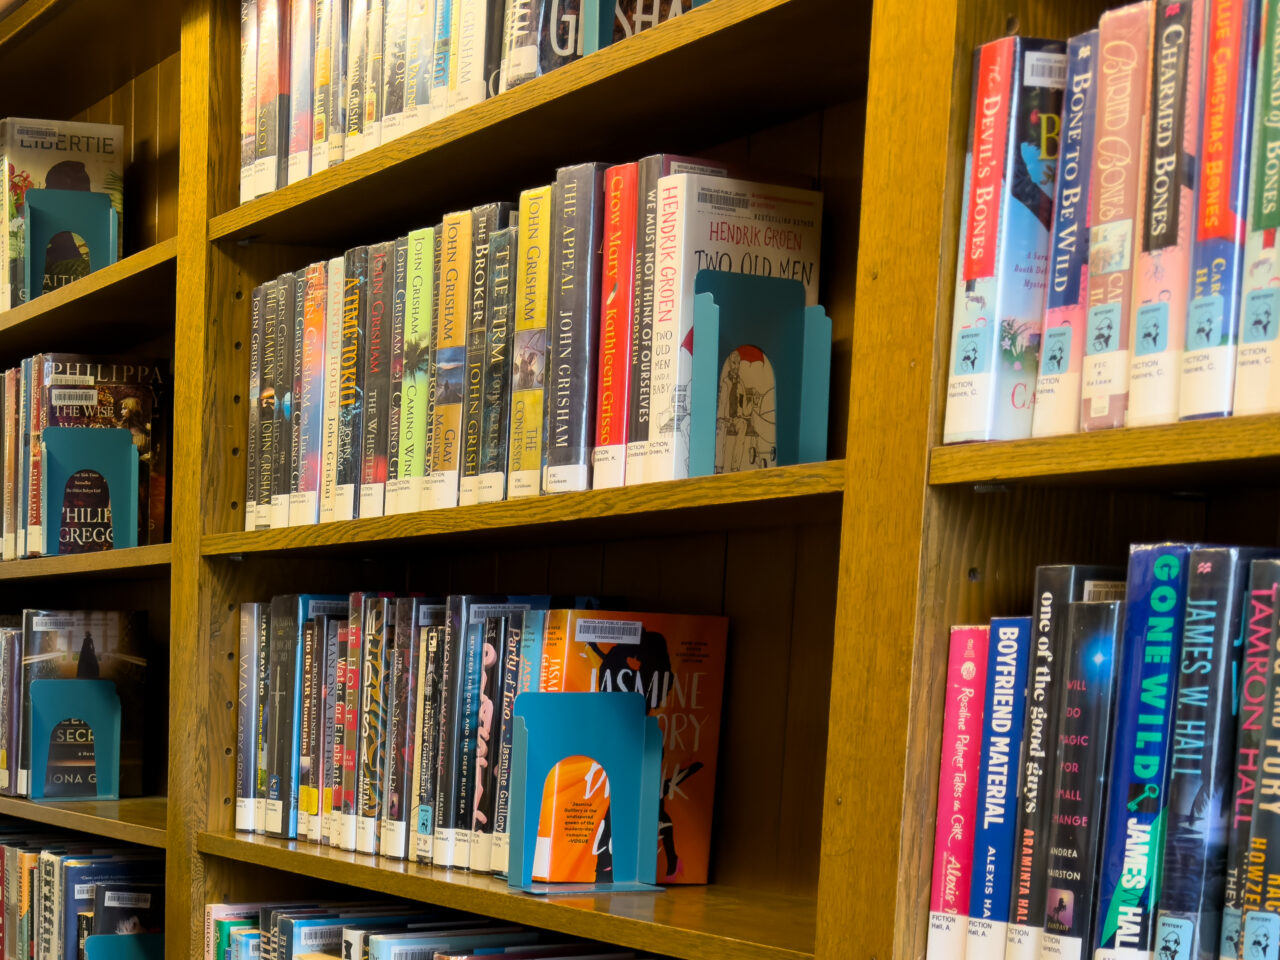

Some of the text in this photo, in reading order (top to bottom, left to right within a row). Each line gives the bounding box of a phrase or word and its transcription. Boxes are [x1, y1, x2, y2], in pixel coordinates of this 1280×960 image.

[1054, 71, 1092, 293] BONE TO BE WILD
[1097, 40, 1138, 221] BURIED BONES
[1150, 24, 1185, 237] CHARMED BONES
[443, 221, 460, 341] JOHN GRISHAM
[524, 196, 543, 321] JOHN GRISHAM
[658, 185, 679, 323] HENDRIK GROEN
[695, 249, 815, 286] TWO OLD MEN
[709, 221, 802, 252] HENDRIK GROEN
[51, 361, 163, 385] PHILIPPA
[303, 264, 319, 407] JOHN GRISHAM
[365, 253, 386, 484] JOHN GRISHAM THE WHISTLER
[389, 246, 407, 452] JOHN GRISHAM CAMINO
[465, 214, 489, 477] THE BROKER JOHN GRISH
[555, 179, 577, 447] THE APPEAL JOHN GRISHAM
[600, 176, 624, 446] Crow Mary Kathleen Grisso
[631, 253, 642, 365] LAUREN GRODSTEIN
[638, 189, 657, 423] WE MUST NOT THINK OF OURSELVES
[654, 360, 671, 371] MEN
[655, 344, 671, 357] OLD
[656, 330, 673, 341] TWO
[55, 404, 114, 418] THE WISE
[443, 429, 455, 464] GRAY
[332, 657, 346, 790] Water for Elephants
[360, 608, 376, 764] MEDUSA
[496, 628, 521, 833] Party of Two Jasmine Guillory
[984, 627, 1019, 830] BOYFRIEND MATERIAL
[1026, 591, 1055, 813] one of the good guys
[1132, 554, 1180, 781] GONE WILD
[1170, 598, 1217, 779] JAMES W. HALL
[1233, 582, 1277, 830] TAMRON HALL
[41, 858, 56, 955] Griffin
[932, 914, 956, 923] FICTION
[1050, 847, 1078, 858] ANDREA
[1225, 868, 1238, 910] THEY
[969, 920, 993, 930] FICTION
